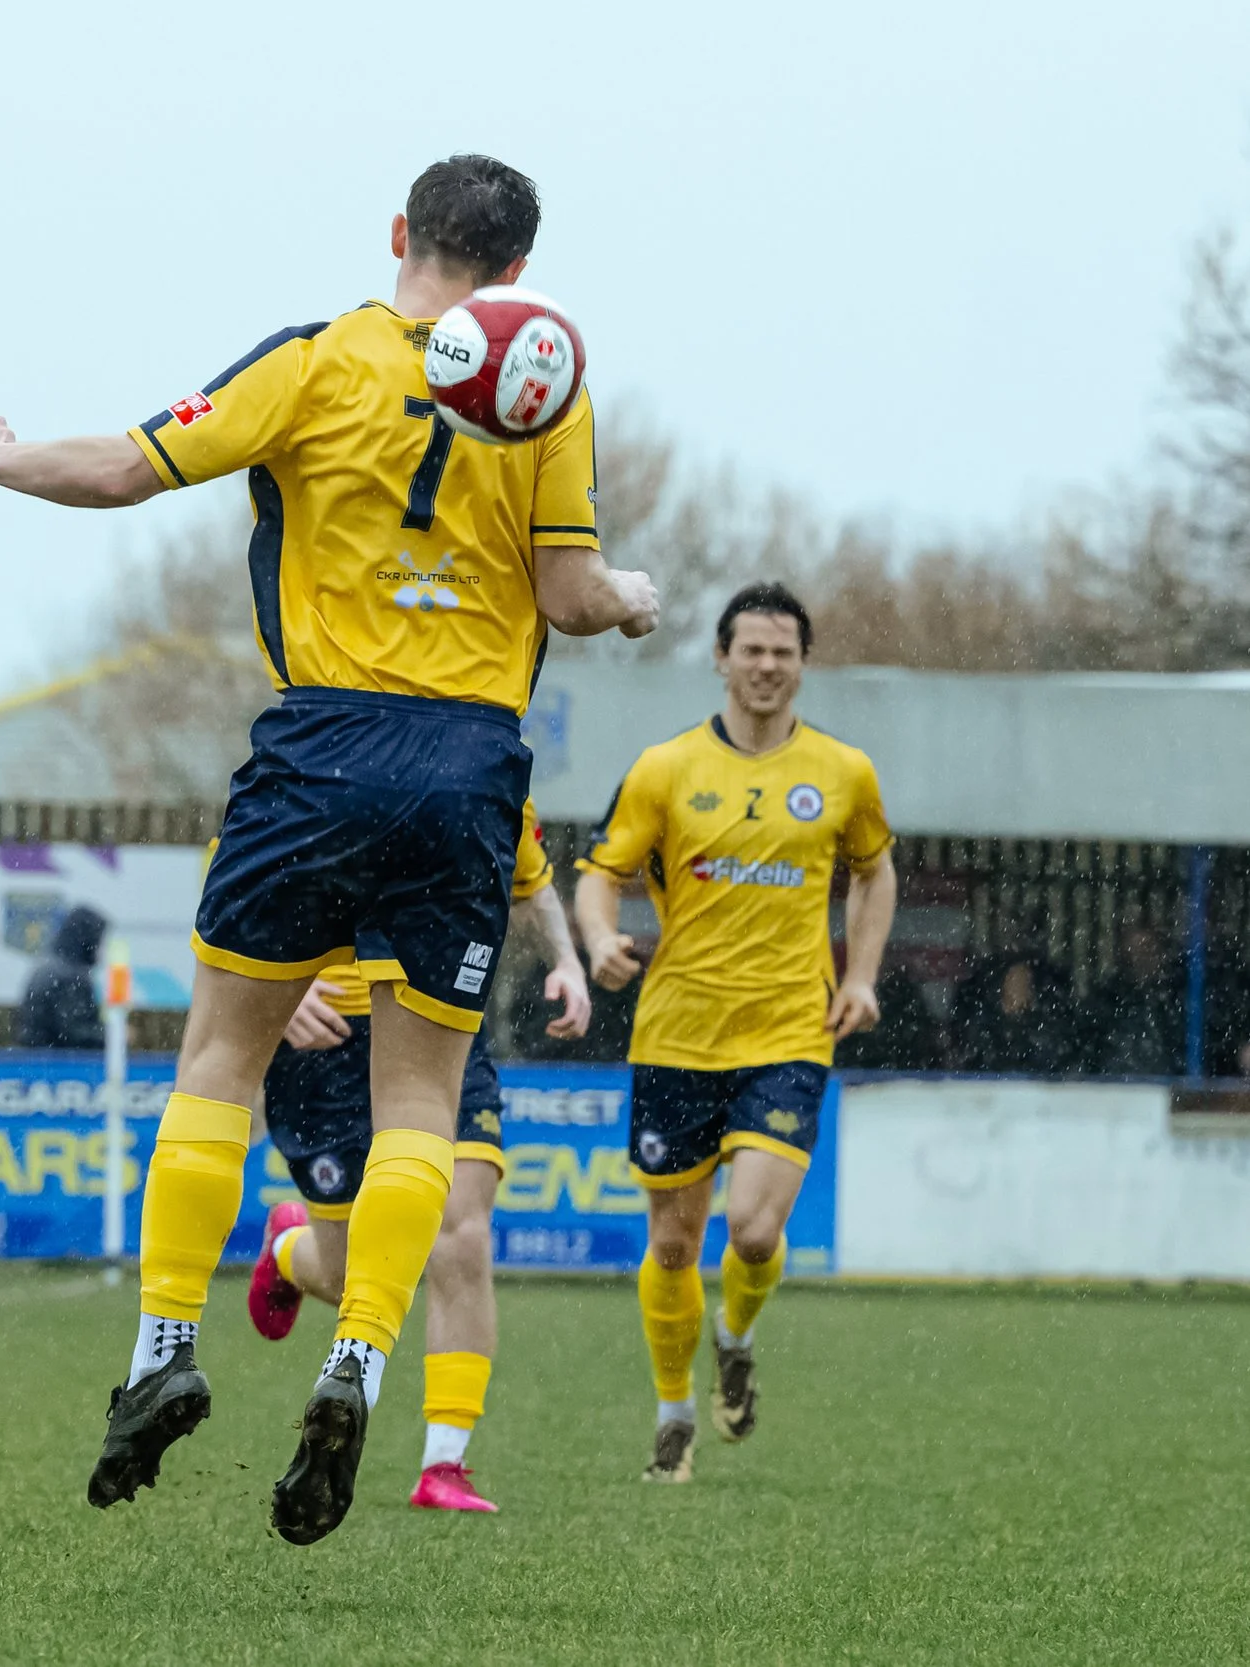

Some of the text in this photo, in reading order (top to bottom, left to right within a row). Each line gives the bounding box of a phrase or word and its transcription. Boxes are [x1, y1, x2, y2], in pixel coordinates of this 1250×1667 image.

[400, 395, 457, 532] 7
[376, 571, 481, 585] CKR UTILITIES LTD
